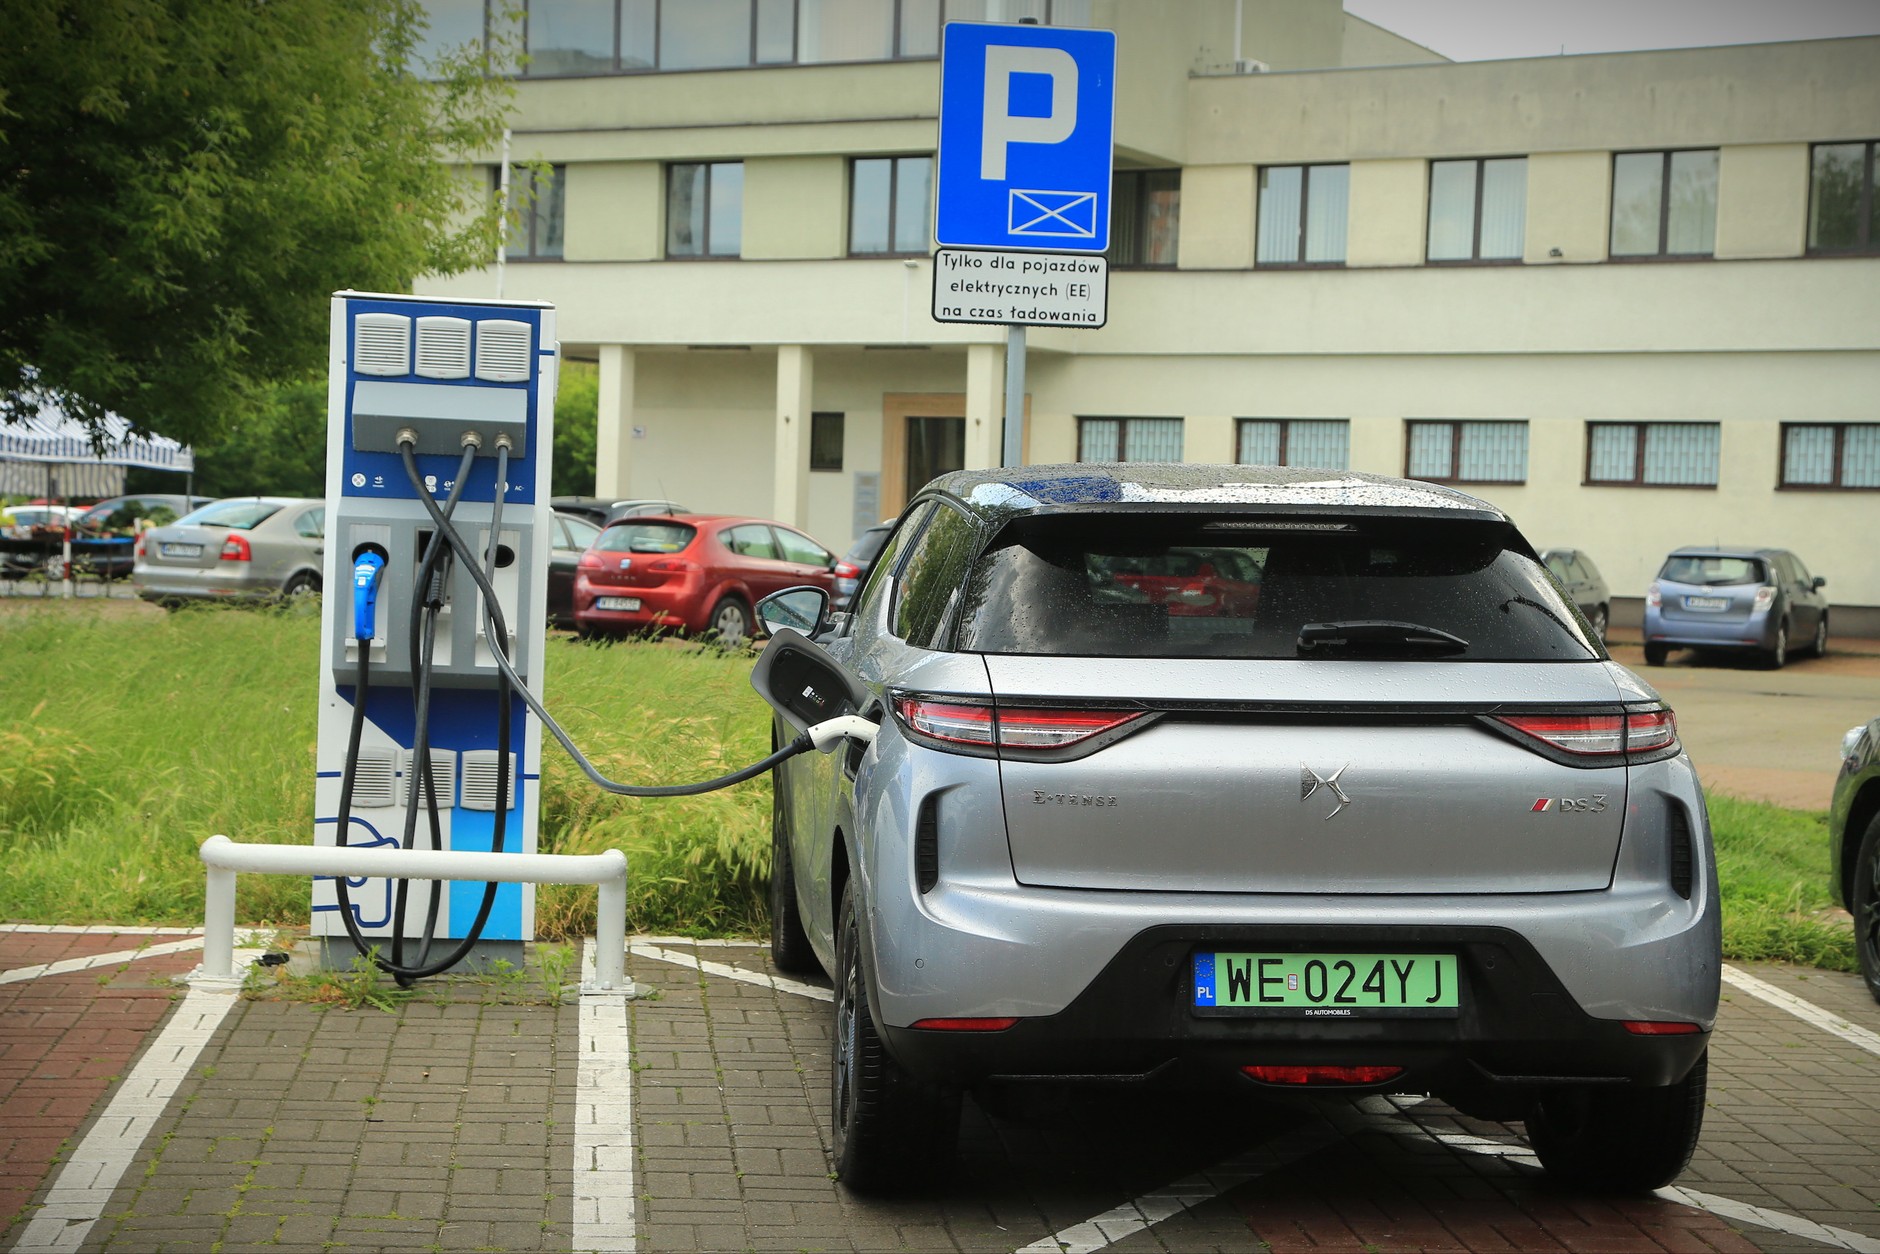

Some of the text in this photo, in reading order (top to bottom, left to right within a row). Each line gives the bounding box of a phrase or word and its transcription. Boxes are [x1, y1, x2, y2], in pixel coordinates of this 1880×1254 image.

[980, 44, 1079, 181] P
[942, 253, 1100, 274] Tylko dla pojazdów
[950, 279, 1091, 301] elektrycznych (EE)
[942, 306, 1097, 322] na czas ładowania
[1226, 958, 1442, 1003] WE 024YJ
[1197, 986, 1213, 999] PL
